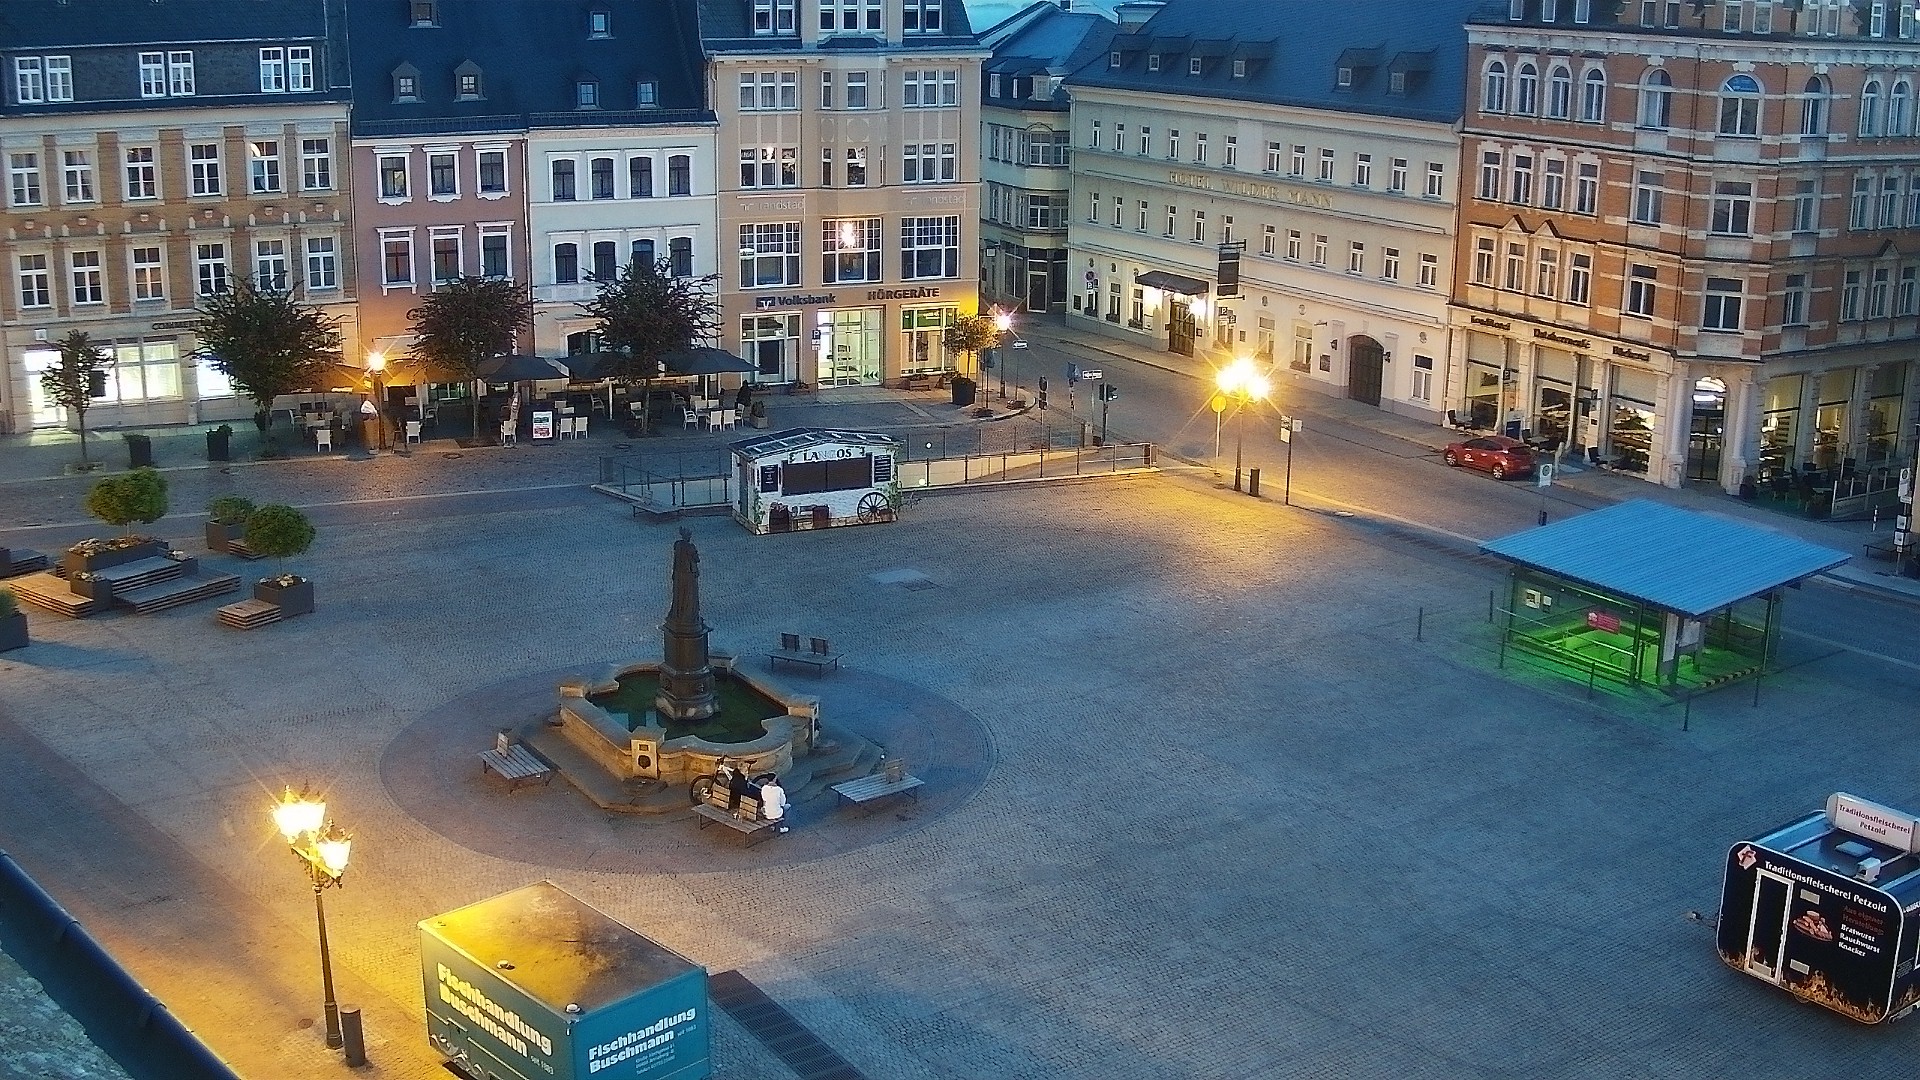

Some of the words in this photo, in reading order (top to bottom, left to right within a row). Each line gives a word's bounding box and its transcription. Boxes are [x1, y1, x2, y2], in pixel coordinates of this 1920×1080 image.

[1170, 171, 1213, 189] HOTEL
[1221, 179, 1280, 199] WILDER
[1288, 190, 1333, 209] MANN
[778, 293, 836, 306] Volksbank
[867, 287, 940, 301] HÖRGERÄTE
[1839, 804, 1910, 834] Traditionsfleischerei
[1860, 821, 1886, 836] Petzold
[1765, 860, 1851, 900] Traditionsfleischerei
[1853, 894, 1887, 913] Petzold
[1840, 932, 1880, 954] Rauchwurst
[1841, 923, 1875, 942] Bratwurst
[1838, 941, 1866, 957] Knacker
[437, 962, 552, 1057] Fischhandlung
[439, 982, 528, 1058] Buschmann
[589, 1007, 696, 1061] Fischhandlung
[590, 1030, 675, 1074] Buschmann
